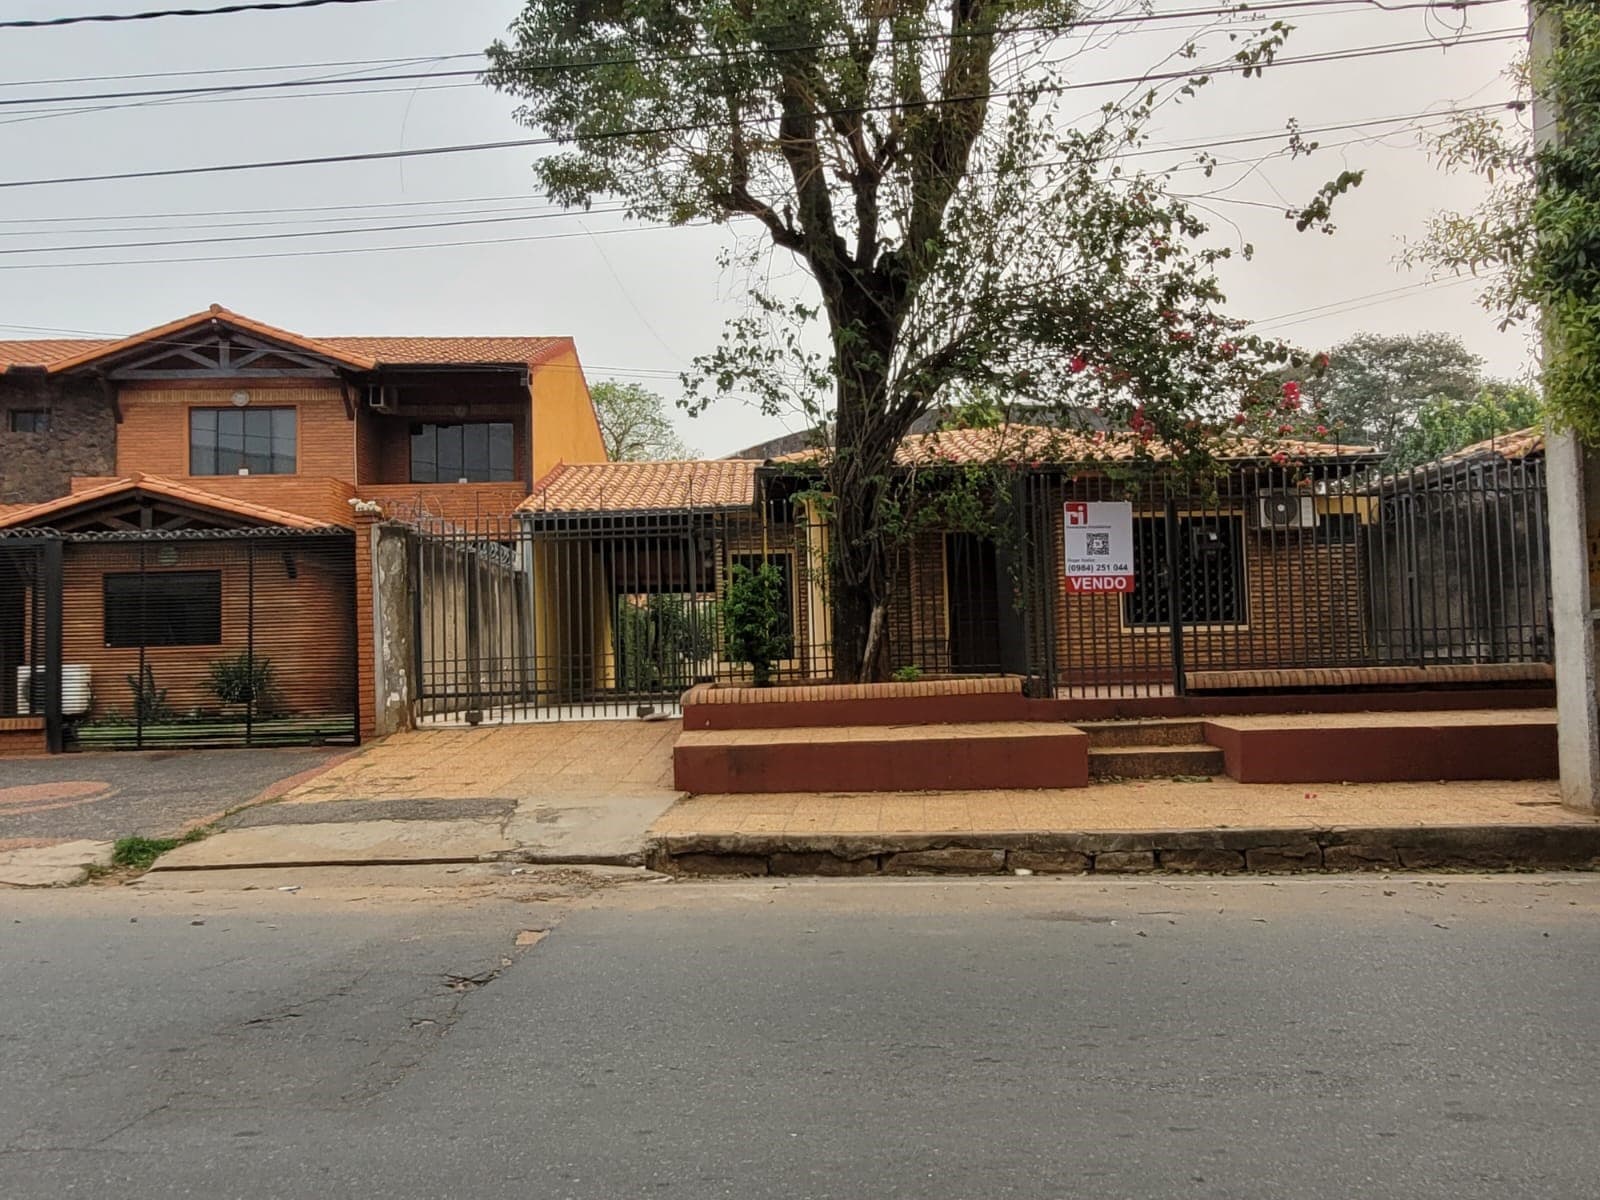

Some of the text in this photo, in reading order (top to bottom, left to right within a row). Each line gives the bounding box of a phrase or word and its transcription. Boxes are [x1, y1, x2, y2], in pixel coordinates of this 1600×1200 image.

[1068, 563, 1128, 573] (0984) 251 044
[1071, 577, 1127, 590] VENDO
